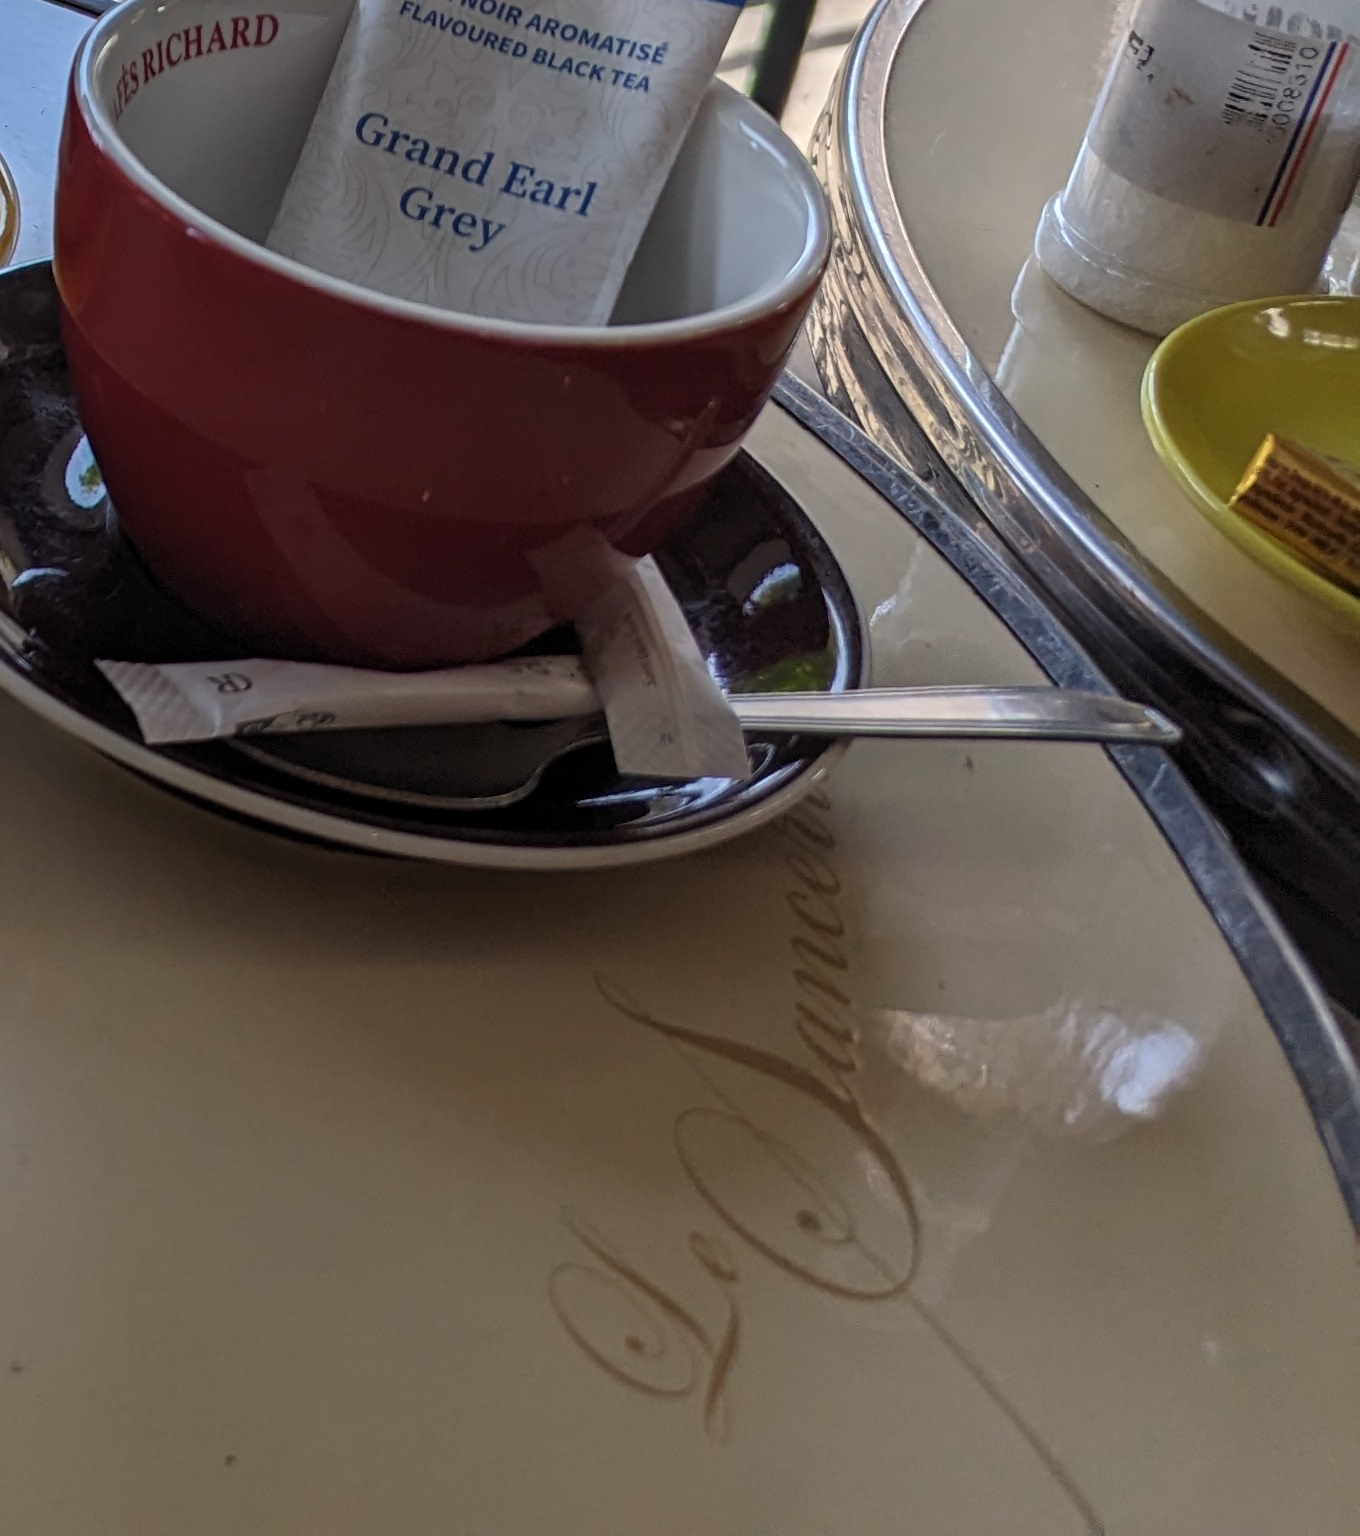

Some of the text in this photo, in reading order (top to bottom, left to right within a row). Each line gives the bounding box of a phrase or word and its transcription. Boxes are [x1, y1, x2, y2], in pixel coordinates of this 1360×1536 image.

[111, 13, 280, 124] AFÉS RICHARD
[398, 0, 651, 93] FLAVOURED BLACK TEA
[525, 13, 669, 65] AROMATISÉ
[354, 111, 598, 217] Grand Earl
[399, 185, 507, 253] Grey
[546, 1200, 742, 1450] Le
